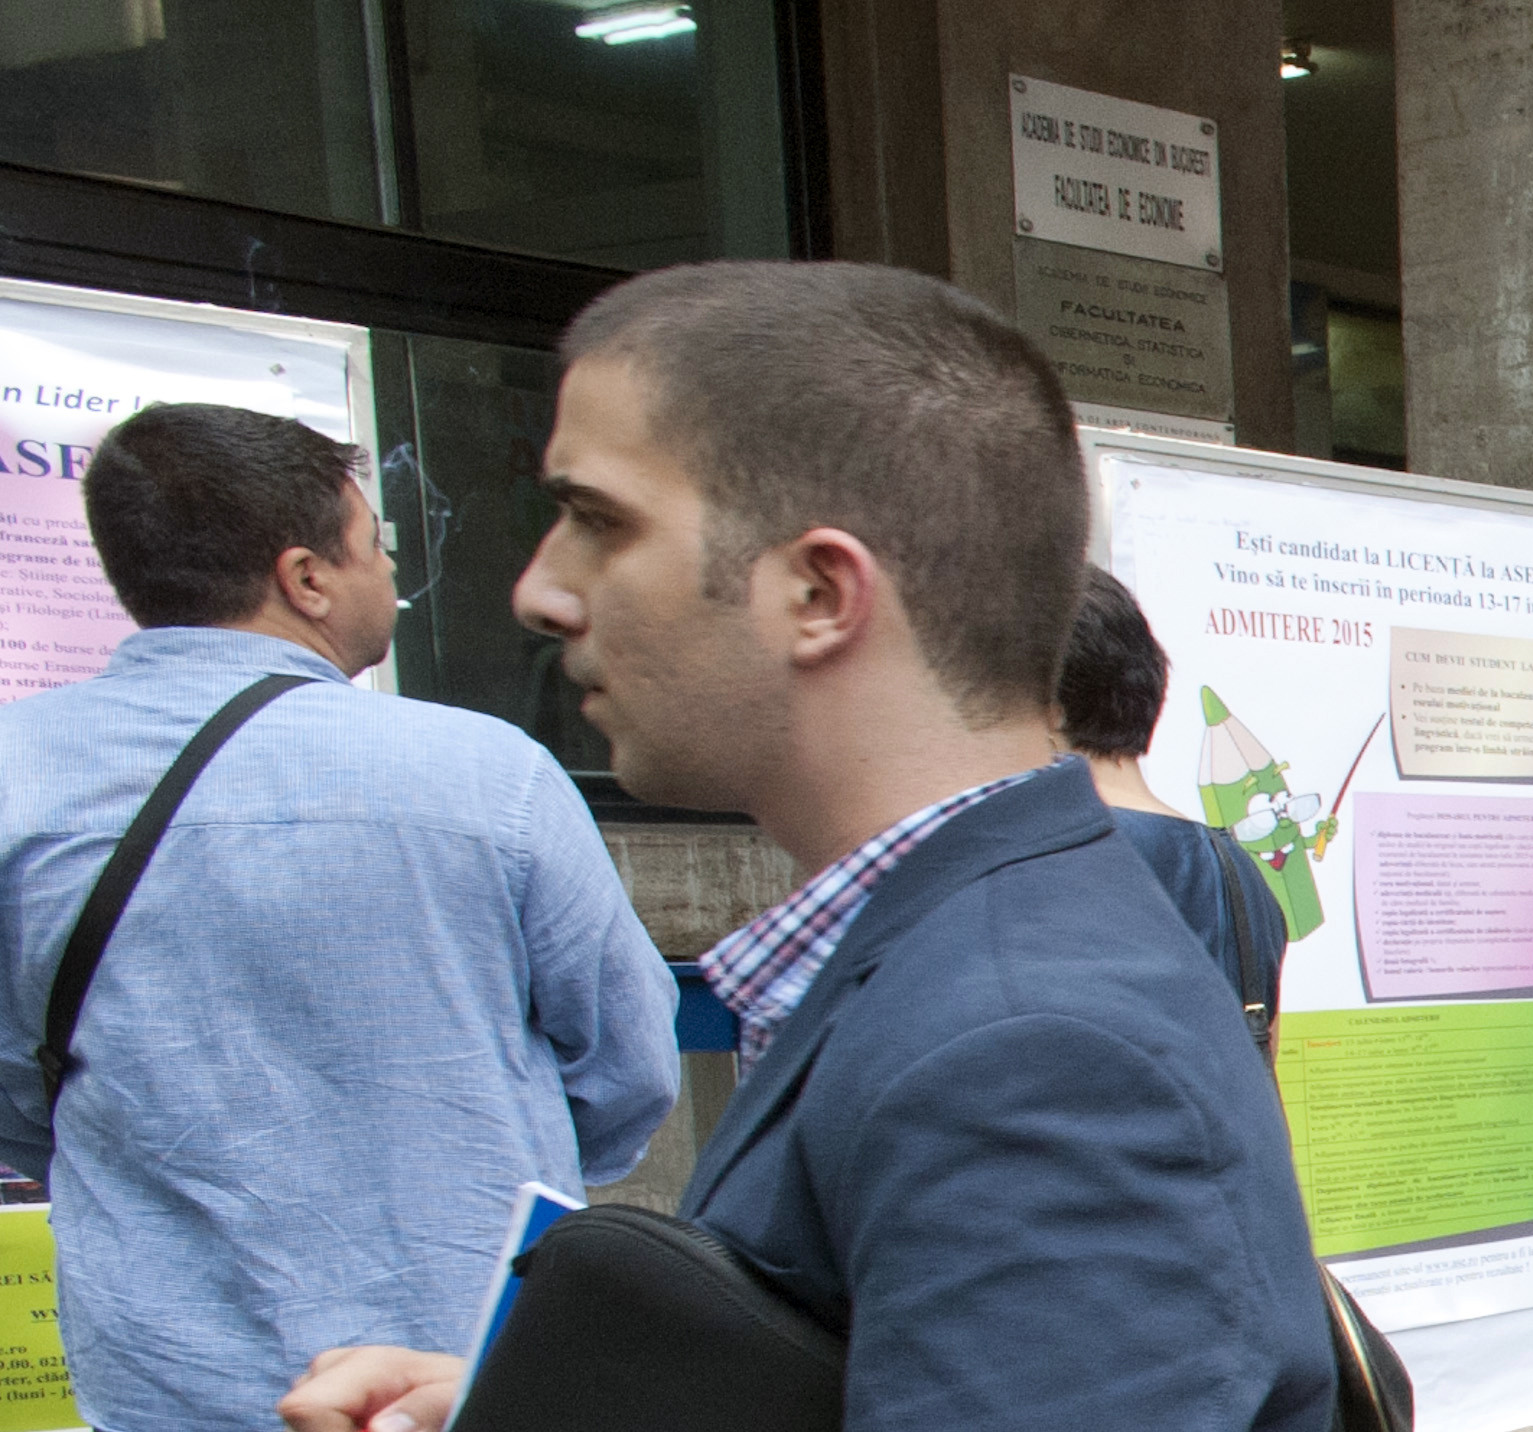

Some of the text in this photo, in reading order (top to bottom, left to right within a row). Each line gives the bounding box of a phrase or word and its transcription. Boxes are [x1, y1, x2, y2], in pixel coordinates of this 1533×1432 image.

[1064, 120, 1076, 148] DE
[1118, 187, 1131, 221] DE
[1061, 301, 1186, 333] FACULTATEA
[36, 385, 120, 413] Lider
[62, 555, 80, 566] de
[1236, 530, 1272, 555] Ești
[1278, 540, 1358, 564] candidat
[1364, 547, 1380, 565] la
[1386, 549, 1475, 579] LICENȚĂ
[1481, 561, 1495, 579] la
[1214, 561, 1260, 586] Vino
[1266, 570, 1285, 588] să
[1291, 573, 1308, 591] te
[1376, 579, 1393, 600] în
[1398, 586, 1472, 607] perioada
[1479, 592, 1521, 613] 13-17
[1205, 607, 1374, 648] ADMITERE 2015
[1405, 651, 1430, 664] CUM
[1435, 653, 1465, 666] DEVII
[1470, 656, 1516, 671] STUDENT
[1521, 662, 1533, 672] LA
[29, 1270, 53, 1284] SĂ
